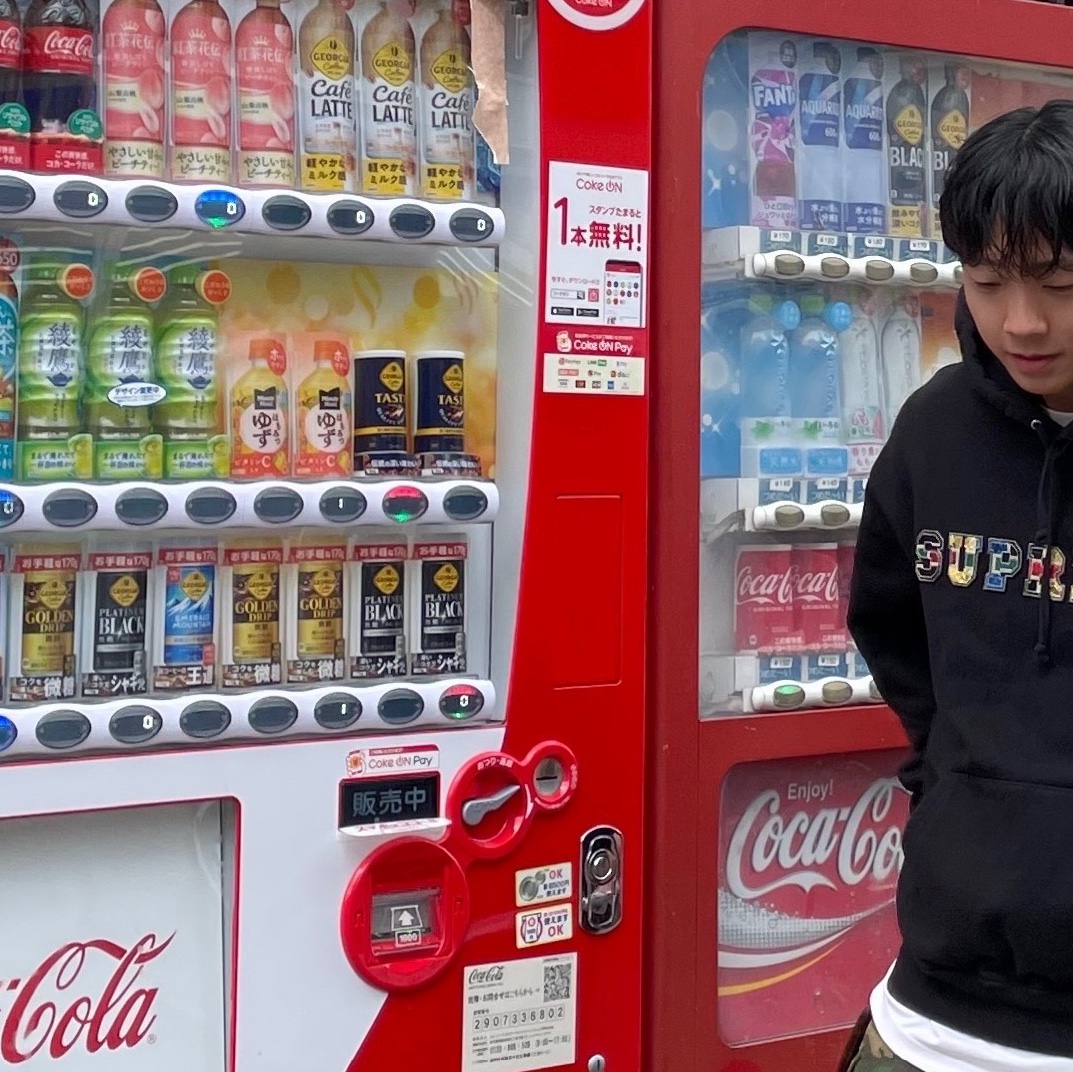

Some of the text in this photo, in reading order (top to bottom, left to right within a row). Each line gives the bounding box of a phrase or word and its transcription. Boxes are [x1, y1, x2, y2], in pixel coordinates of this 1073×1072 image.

[310, 79, 352, 99] Café
[373, 85, 413, 104] Café
[310, 98, 353, 119] LATTE
[431, 91, 470, 110] Café
[373, 104, 414, 126] LATTE
[575, 178, 605, 191] Coke
[573, 339, 598, 350] Coke
[614, 342, 634, 356] Pay
[252, 412, 272, 448] ゆず
[317, 412, 336, 448] ゆず
[368, 758, 394, 769] Coke
[412, 755, 434, 767] Pay
[787, 779, 834, 802] Enjoy!
[352, 785, 426, 817] 販売中
[726, 776, 906, 900] Coca-Co
[548, 868, 563, 880] OK
[547, 924, 564, 938] OK
